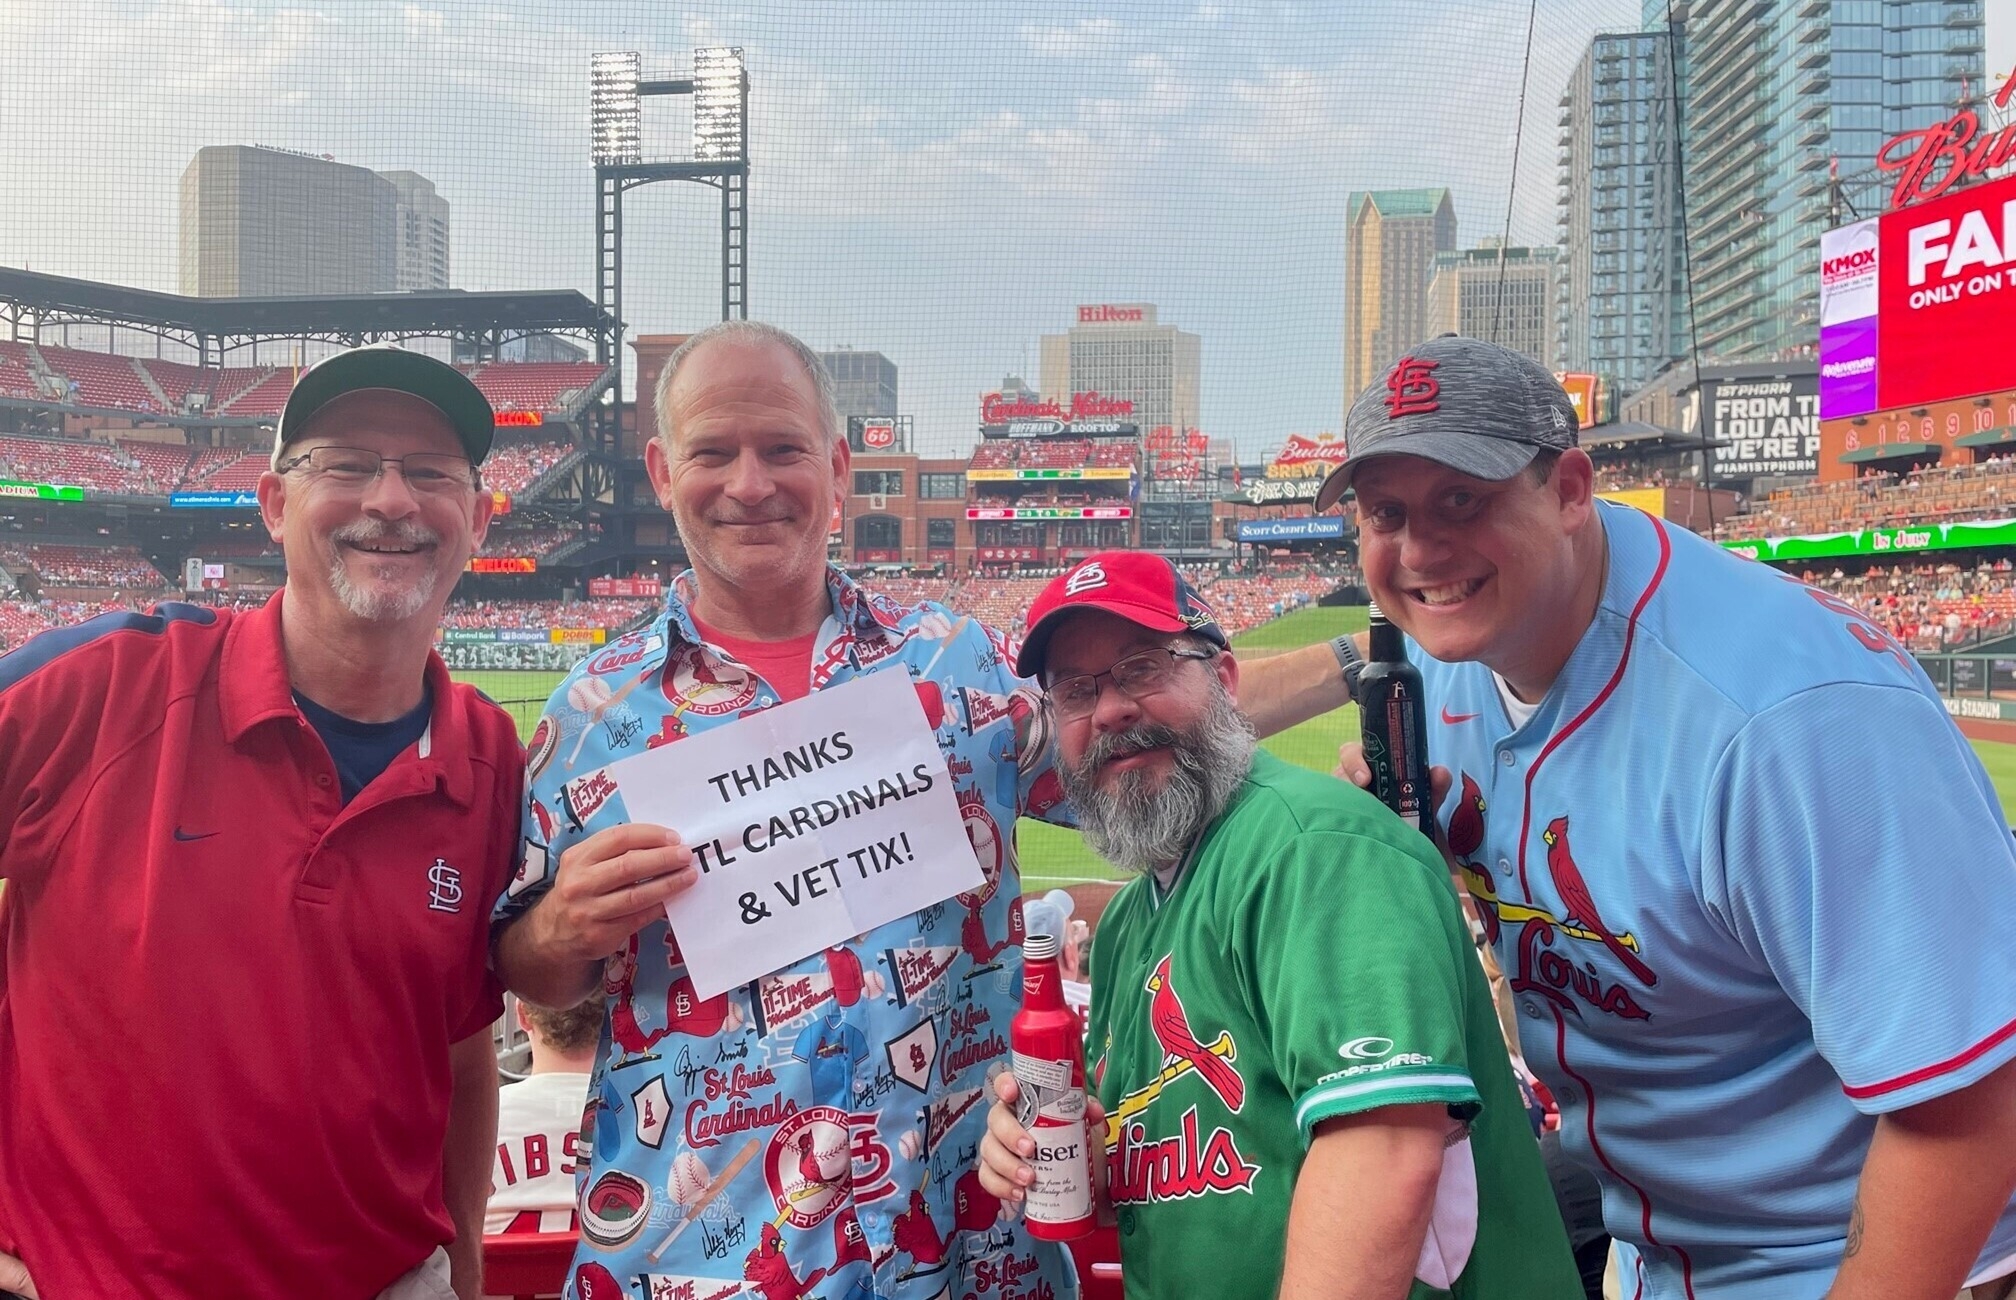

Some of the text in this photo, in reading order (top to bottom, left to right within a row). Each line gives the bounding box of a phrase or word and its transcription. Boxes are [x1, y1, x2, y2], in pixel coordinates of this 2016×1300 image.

[1823, 248, 1876, 276] KMOX
[1909, 282, 1964, 309] ONLY
[1968, 273, 2002, 295] ON
[1079, 304, 1142, 322] Hilton
[983, 390, 1134, 423] Cardinals Nation
[1715, 397, 1791, 419] FROM
[1070, 423, 1121, 433] ROOFTOP
[1715, 419, 1766, 440] LOU
[1897, 420, 1910, 443] 2
[1921, 417, 1934, 440] 6
[1946, 413, 1960, 437] 9
[1973, 408, 1994, 433] 10
[868, 429, 890, 442] 66
[1878, 424, 1887, 444] 1
[1715, 437, 1799, 461] WE'RE
[1267, 464, 1319, 479] BREW
[1713, 460, 1817, 473] #IAM1STPHORM
[454, 632, 480, 640] Central
[511, 631, 546, 641] Ballpark
[562, 631, 596, 639] DOBBS
[708, 731, 854, 803] THANKS
[692, 763, 934, 874] TL CARDINALS
[967, 808, 994, 829] LOUIS
[738, 831, 915, 925] & VET TIX!
[726, 1063, 777, 1099] Louis
[685, 1092, 800, 1149] Cardinals
[776, 1109, 850, 1146] ST. LOUIS
